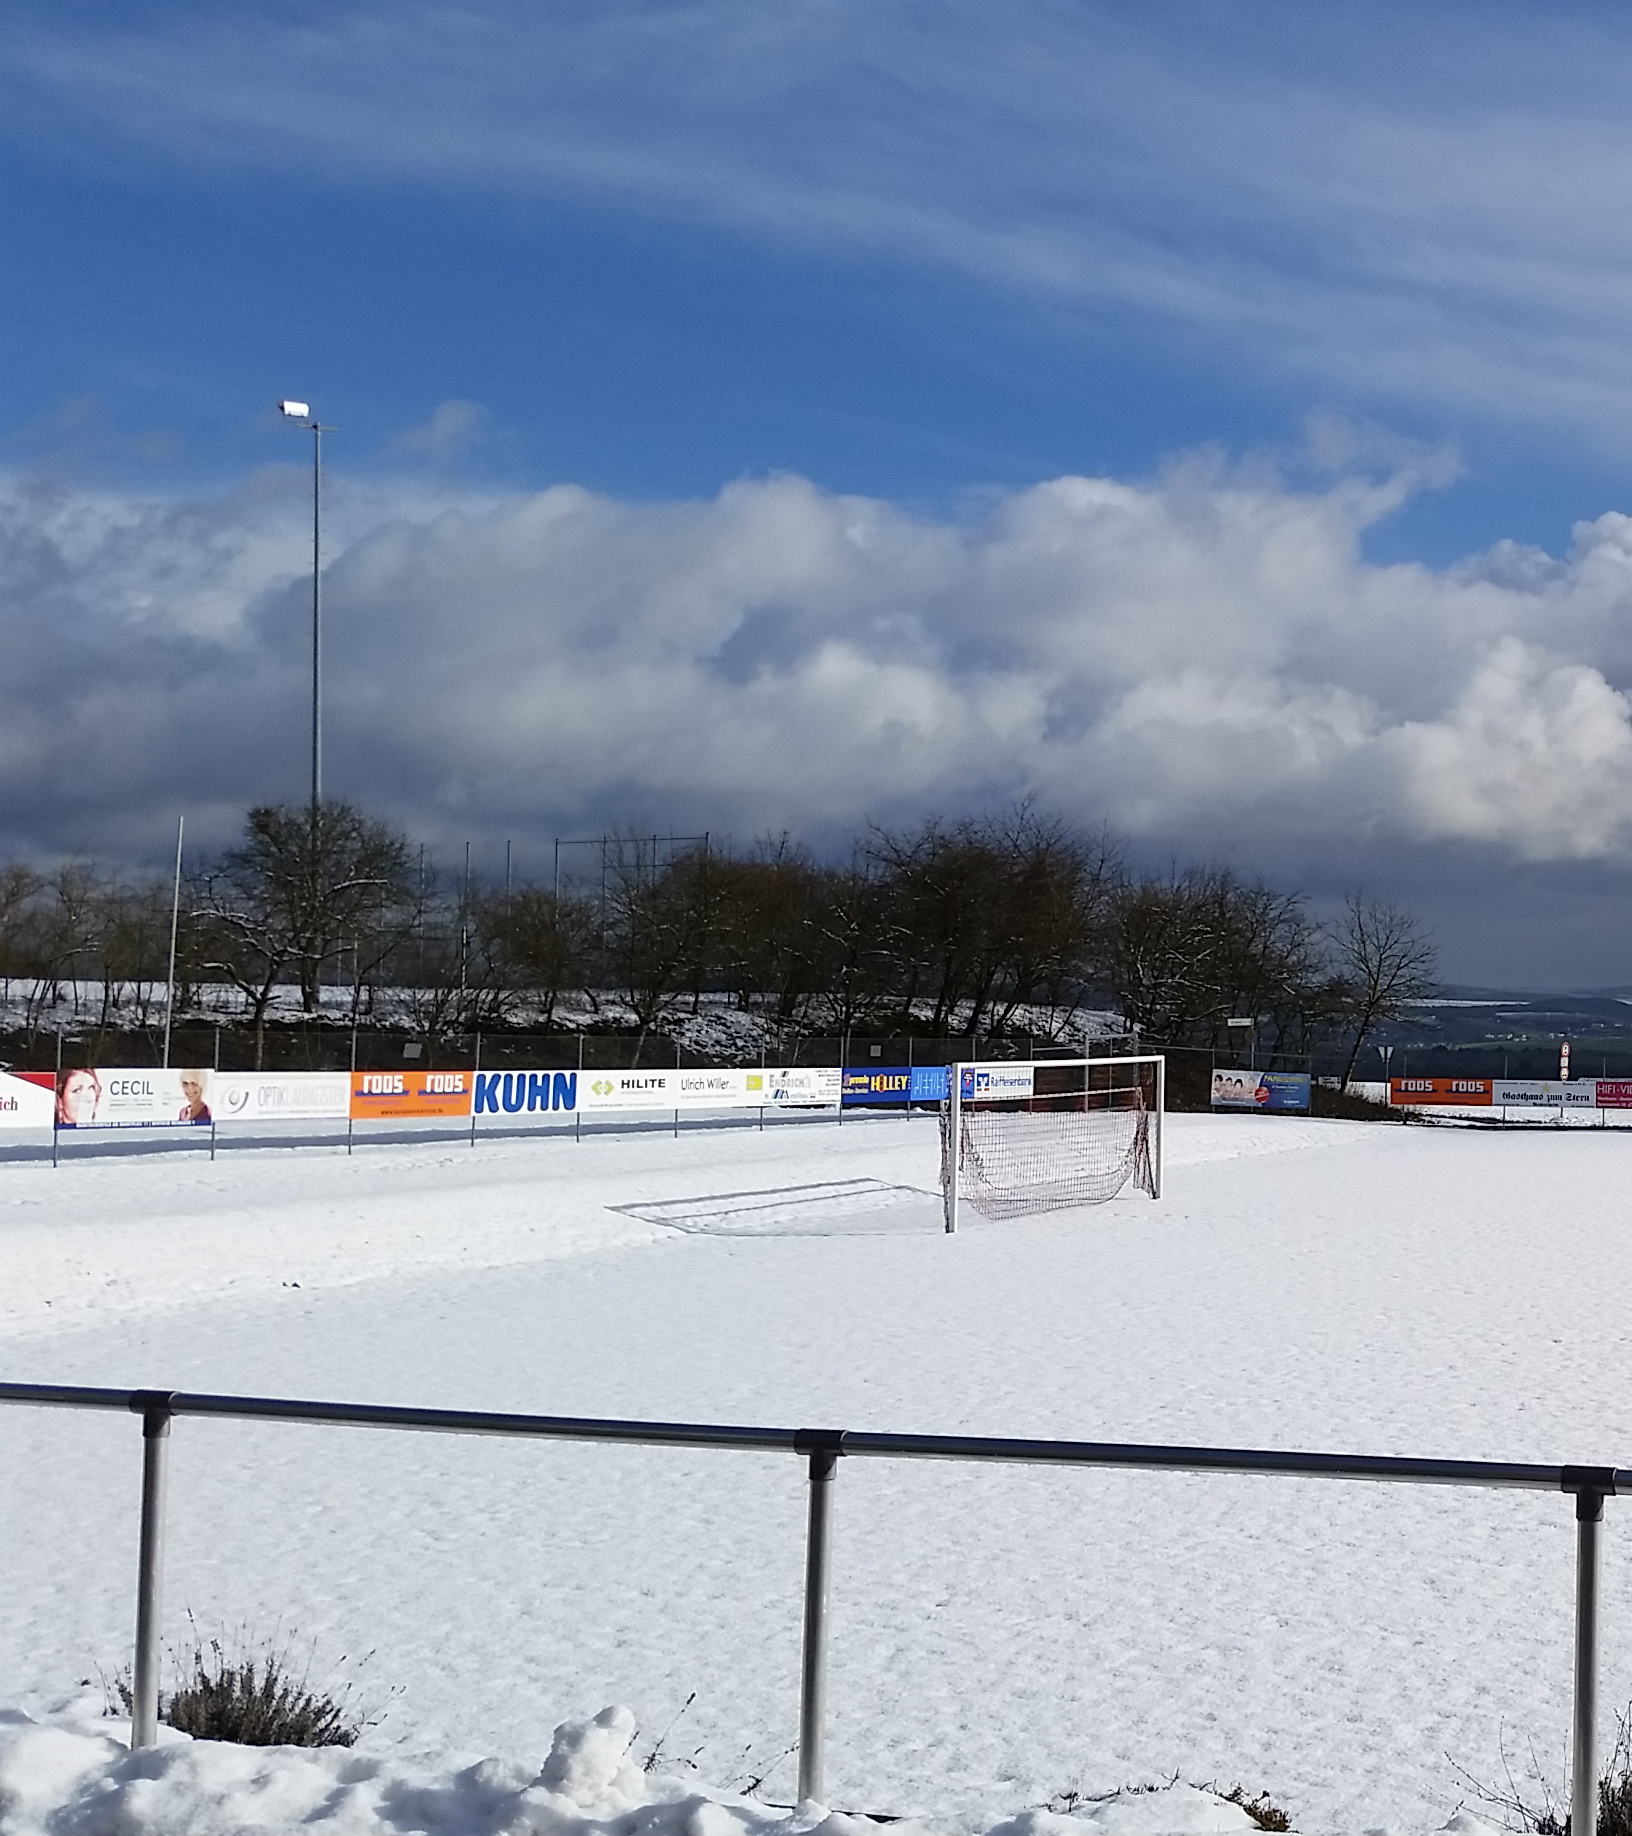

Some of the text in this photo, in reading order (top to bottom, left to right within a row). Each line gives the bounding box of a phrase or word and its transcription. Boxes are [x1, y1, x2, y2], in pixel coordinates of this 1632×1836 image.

[109, 1080, 154, 1096] CECIL
[362, 1074, 404, 1094] roos
[426, 1074, 464, 1093] roos
[620, 1078, 667, 1090] HILITE
[680, 1077, 730, 1091] Ulrich Willer
[990, 1076, 1032, 1088] Raiffeisenbank
[1400, 1080, 1434, 1092] roos
[1451, 1081, 1485, 1093] roos
[474, 1072, 578, 1113] KUHN
[1502, 1091, 1544, 1102] Gasthaus
[1547, 1093, 1563, 1102] zum
[1565, 1092, 1590, 1102] Stern
